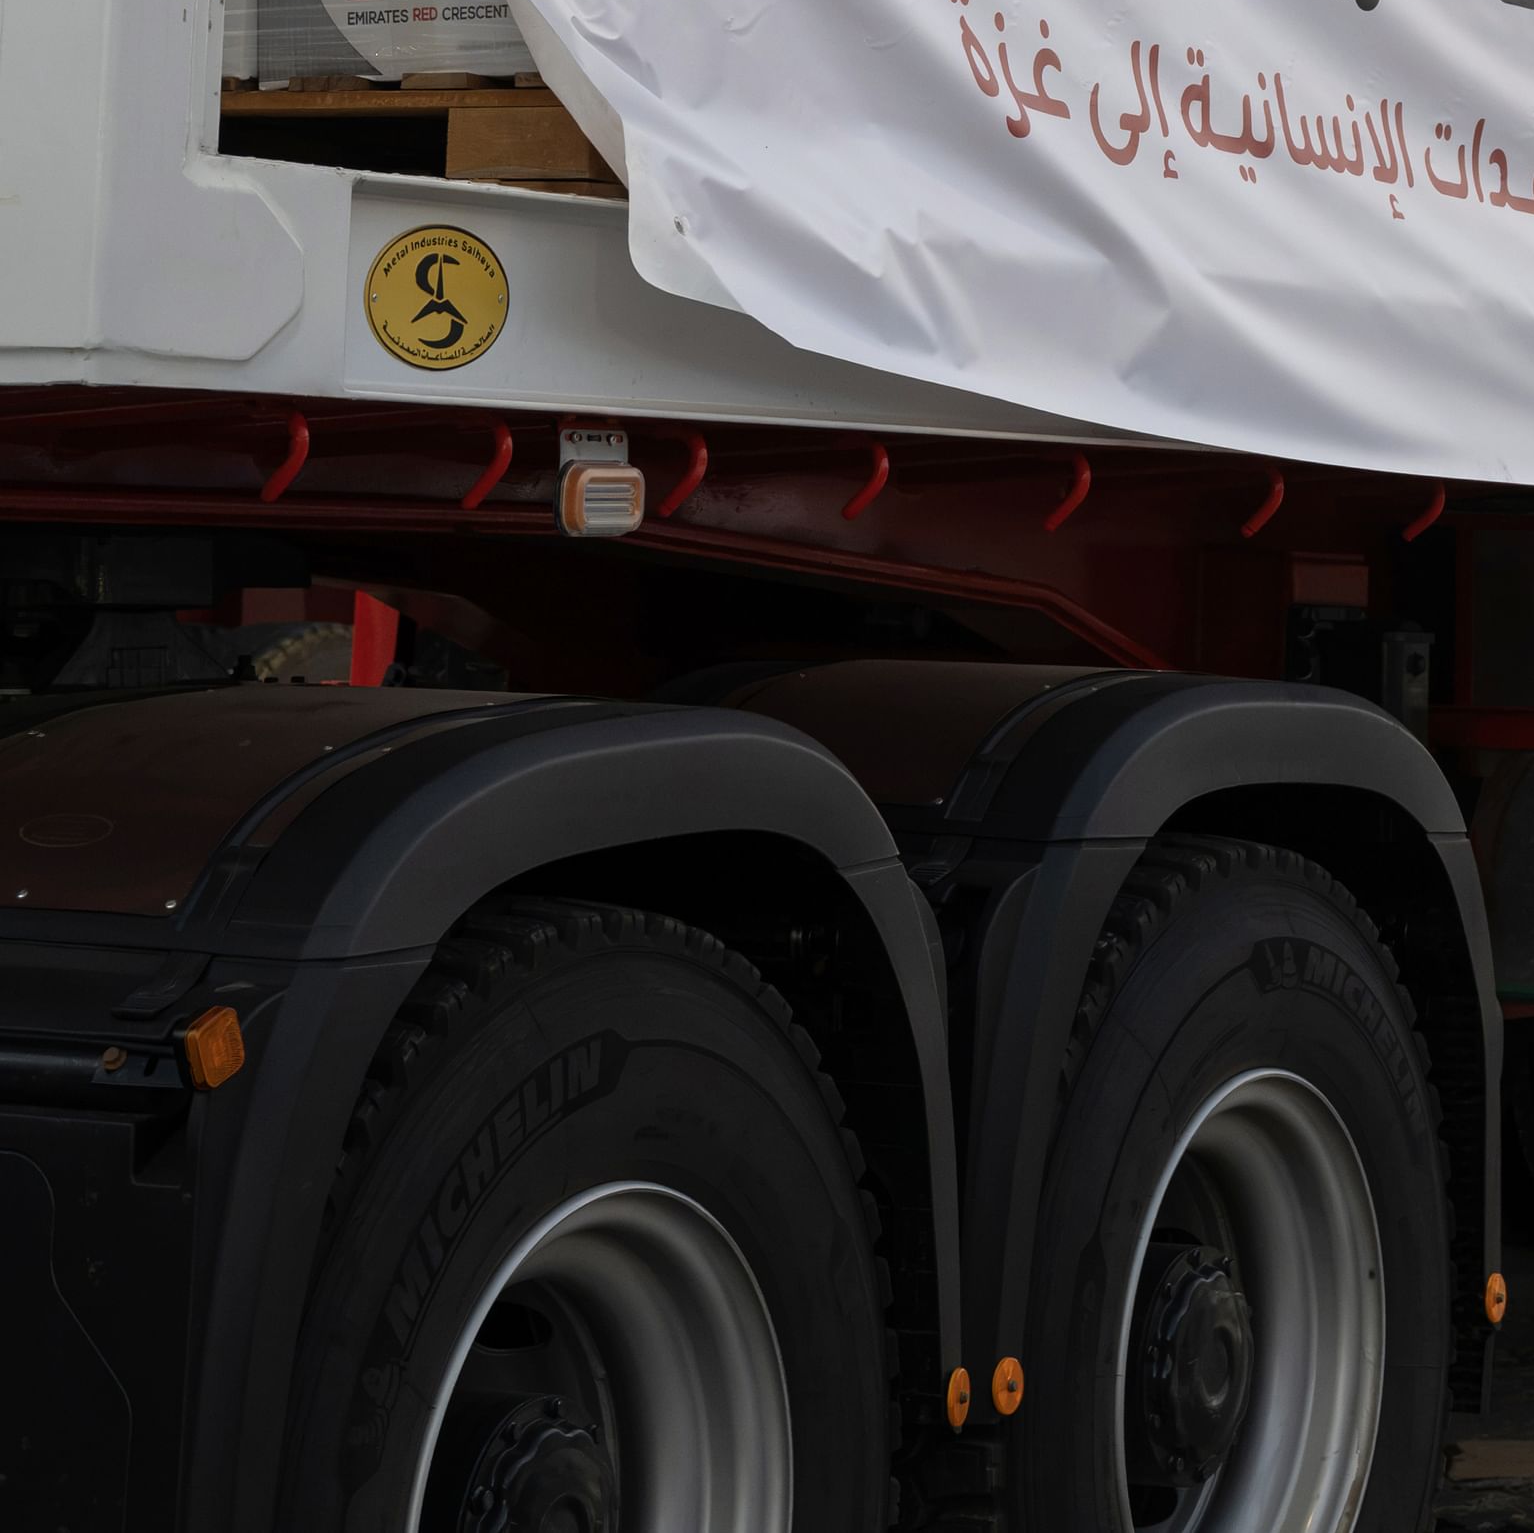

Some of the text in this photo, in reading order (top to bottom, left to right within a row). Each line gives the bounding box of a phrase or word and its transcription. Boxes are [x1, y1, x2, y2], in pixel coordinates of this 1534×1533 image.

[347, 4, 509, 26] EMIRATES RED CRESCENT
[1089, 40, 1180, 181] إلى
[1181, 48, 1415, 221] الإنسانية
[383, 245, 408, 278] Metal
[411, 236, 459, 252] Industries
[1304, 945, 1428, 1134] MICHELIN
[385, 1036, 602, 1347] MICHELIN
